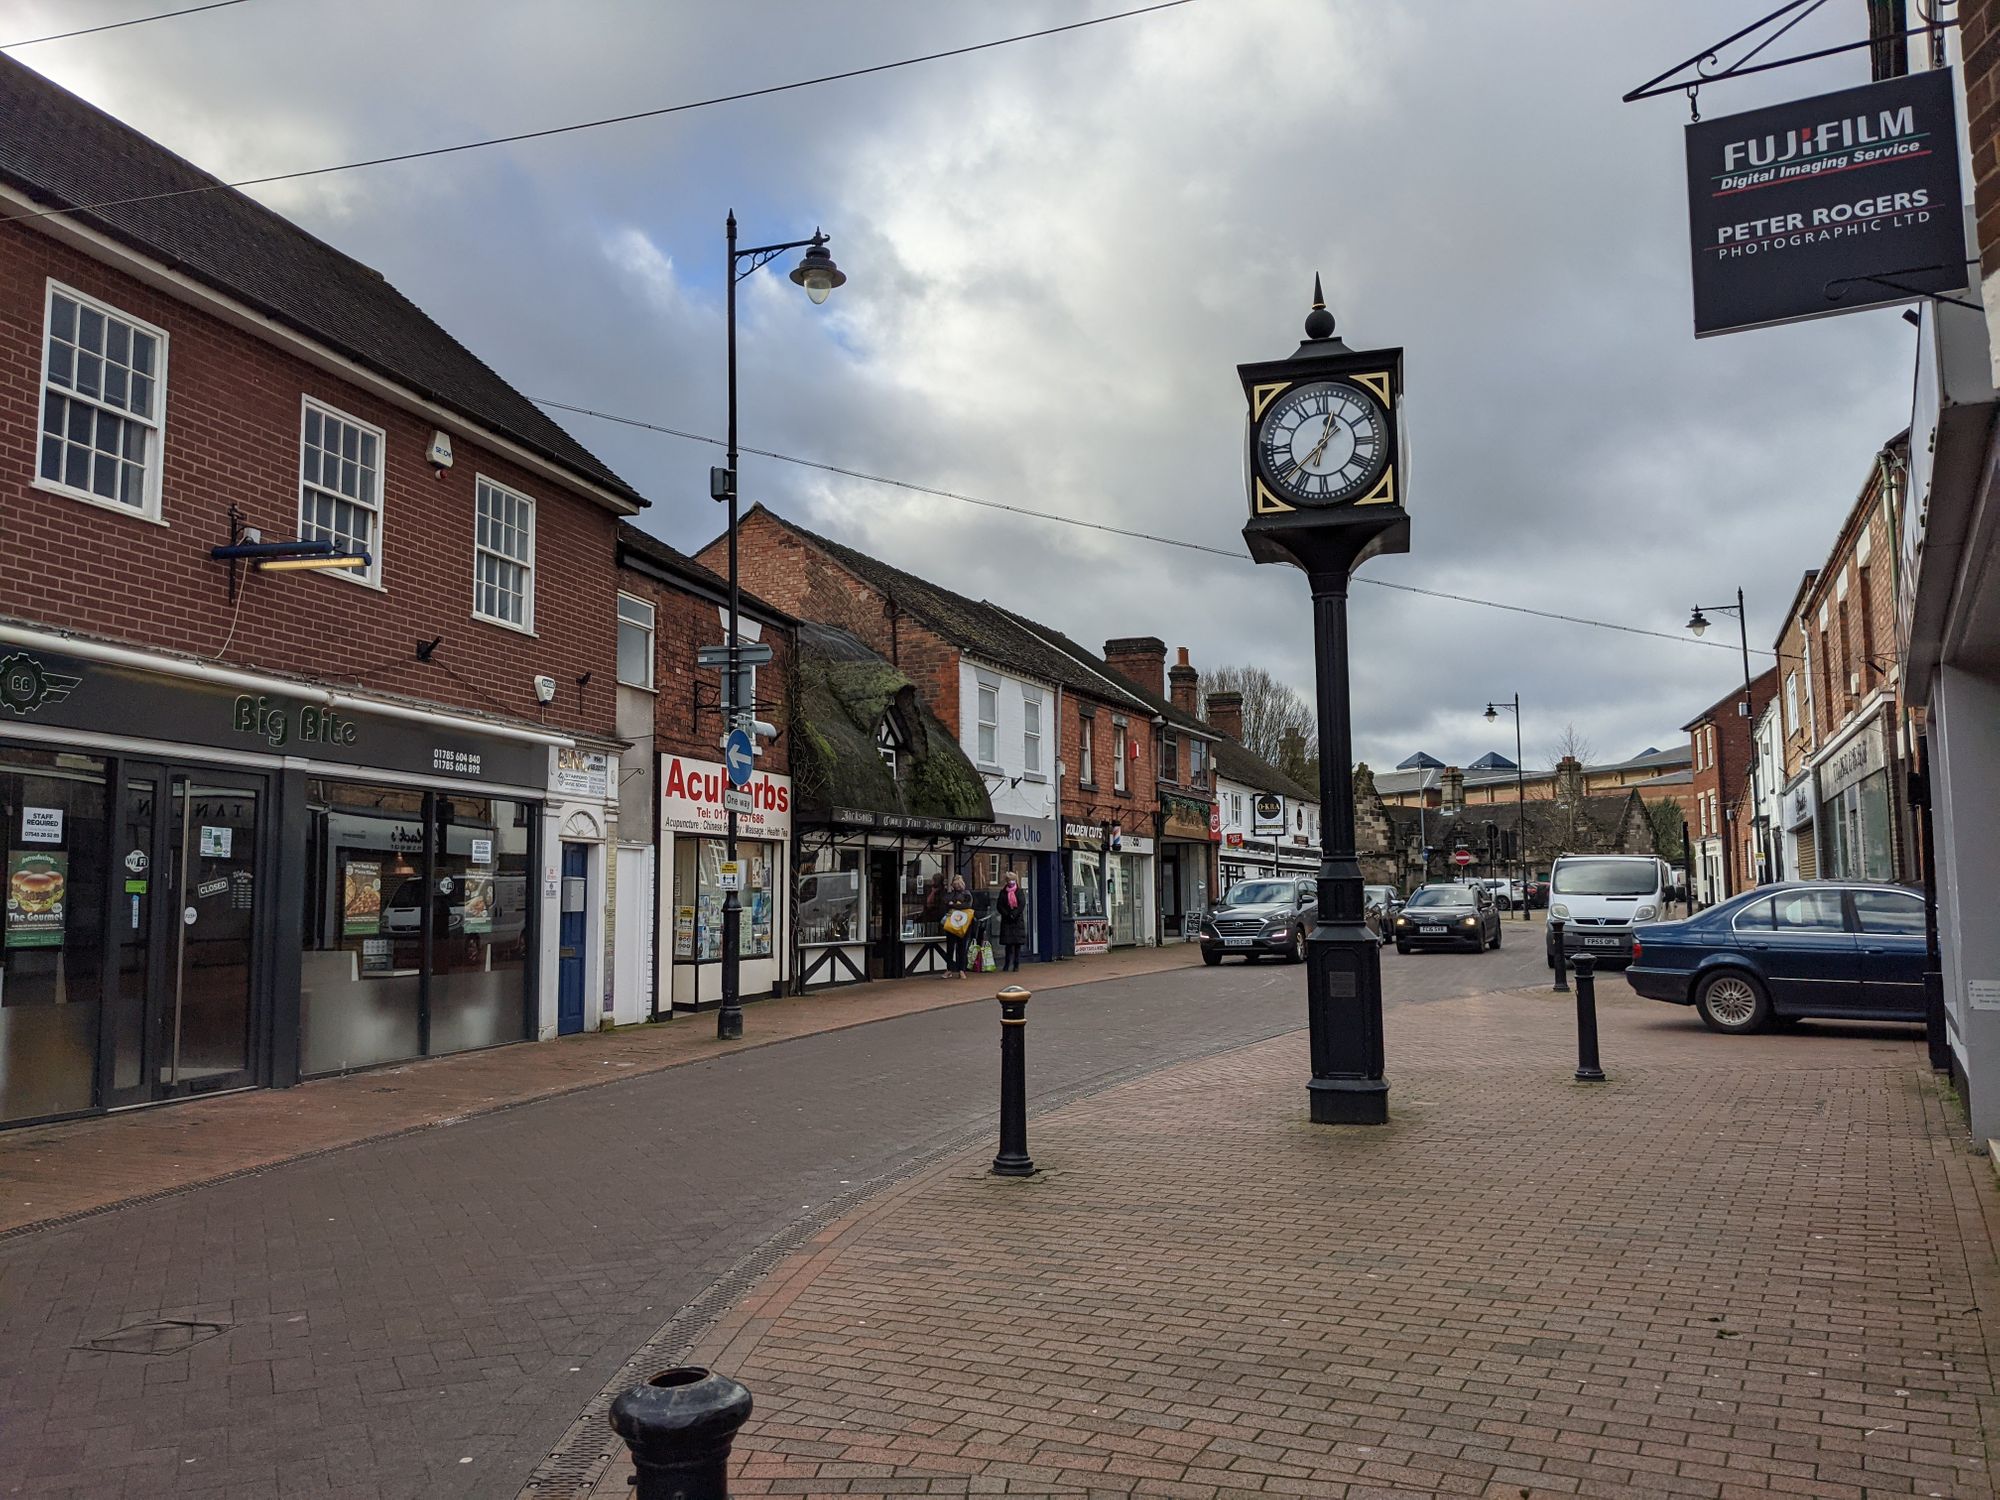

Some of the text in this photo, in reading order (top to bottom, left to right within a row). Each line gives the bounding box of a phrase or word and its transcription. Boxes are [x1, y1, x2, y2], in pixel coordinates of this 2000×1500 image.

[1724, 105, 1914, 171] FUJIFILM
[1721, 141, 1920, 190] Digital Imaging Service
[1718, 189, 1929, 244] PETER ROGERS
[1719, 211, 1930, 260] PHOTOGRAPHIC LTD
[233, 694, 359, 747] Big Bite
[433, 749, 481, 764] 01785 604 840
[433, 760, 454, 771] 01785
[455, 761, 468, 773] 604
[726, 794, 750, 809] One way
[33, 812, 53, 820] STAFF
[697, 807, 711, 819] Tel:
[27, 819, 59, 827] REQUIRED
[665, 816, 699, 830] Acupuncture
[703, 821, 722, 832] Chinese
[1023, 824, 1042, 842] Uno
[1065, 823, 1103, 839] GOLDEN CUTS
[200, 881, 227, 894] CLOSED
[9, 911, 63, 921] The Gourmet
